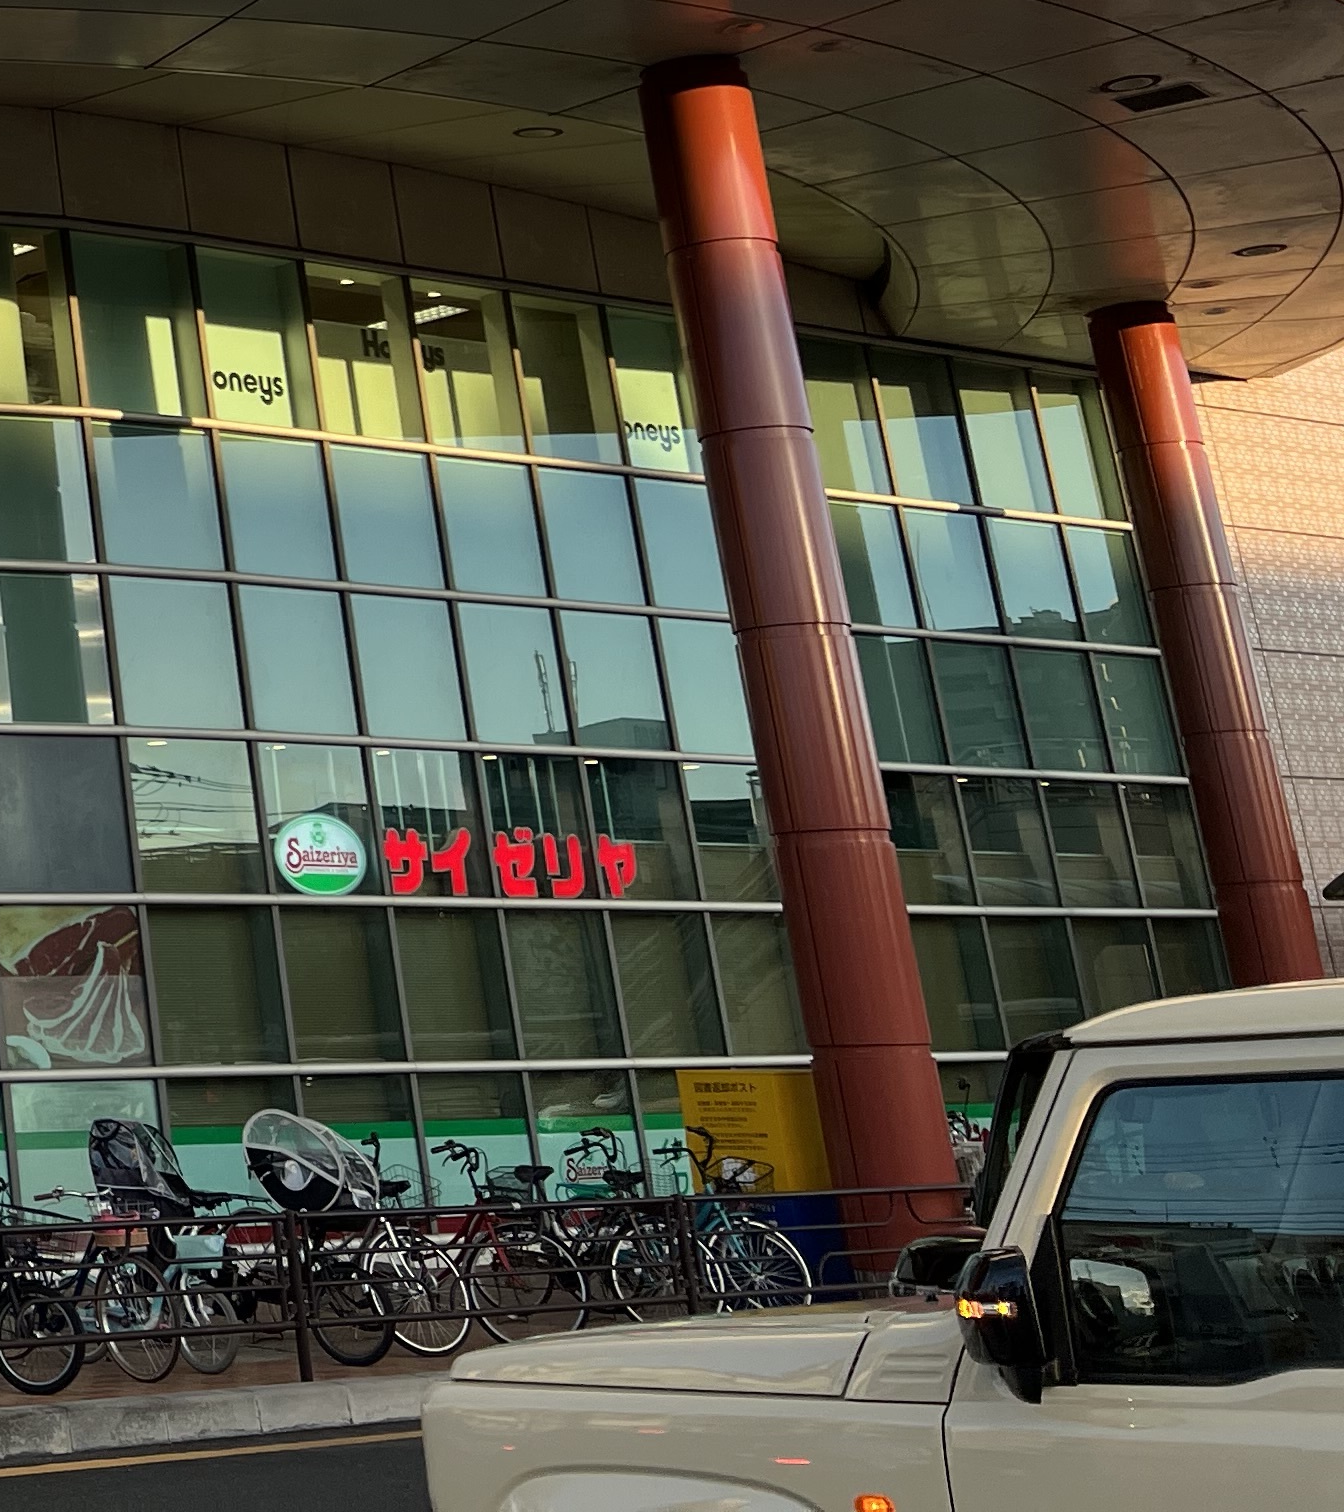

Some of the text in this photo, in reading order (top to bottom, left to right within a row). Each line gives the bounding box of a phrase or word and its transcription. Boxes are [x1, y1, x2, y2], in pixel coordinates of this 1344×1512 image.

[212, 370, 284, 405] oneys
[285, 837, 358, 871] Saizeriya
[383, 826, 637, 899] サイゼリヤ
